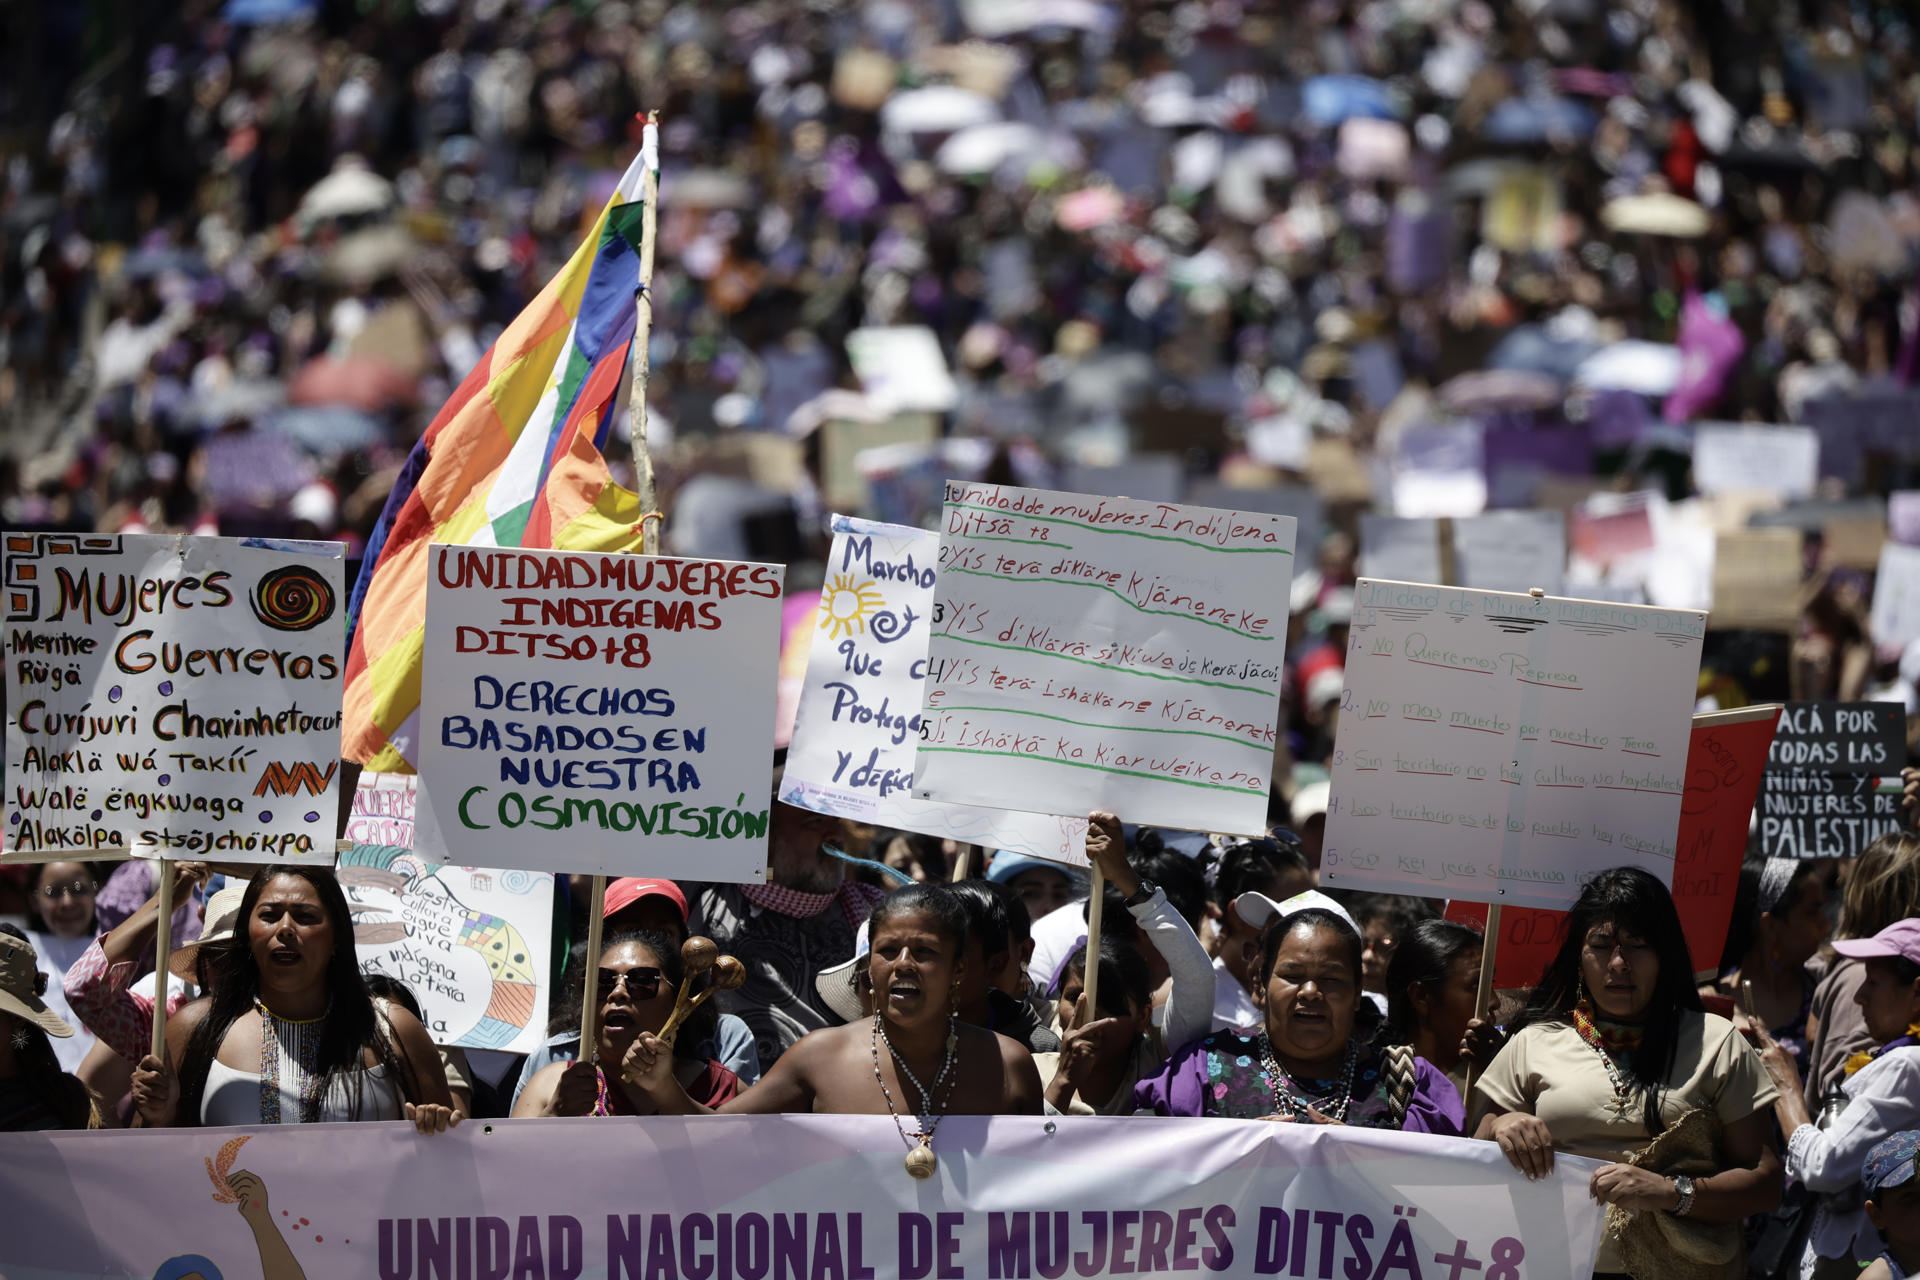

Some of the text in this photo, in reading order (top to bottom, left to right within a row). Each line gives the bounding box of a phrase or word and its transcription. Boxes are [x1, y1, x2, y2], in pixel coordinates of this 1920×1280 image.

[45, 567, 232, 627] Mujeres
[500, 597, 722, 632] INDIGENAS
[1449, 590, 1474, 612] de
[115, 629, 339, 679] Guerreras
[474, 675, 675, 717] DERECHOS
[1776, 704, 1878, 734] ACÁ POR
[1848, 741, 1887, 763] LAS
[500, 756, 701, 793] NUESTRA
[1766, 766, 1869, 792] NIÑAS Y
[458, 785, 768, 840] COSMOVISIÓN
[1765, 793, 1896, 815] MUJERES DE
[378, 1215, 582, 1280] UNIDAD
[607, 1212, 875, 1280] NACIONAL
[898, 1212, 964, 1280] DE
[987, 1204, 1236, 1280] MUJERES
